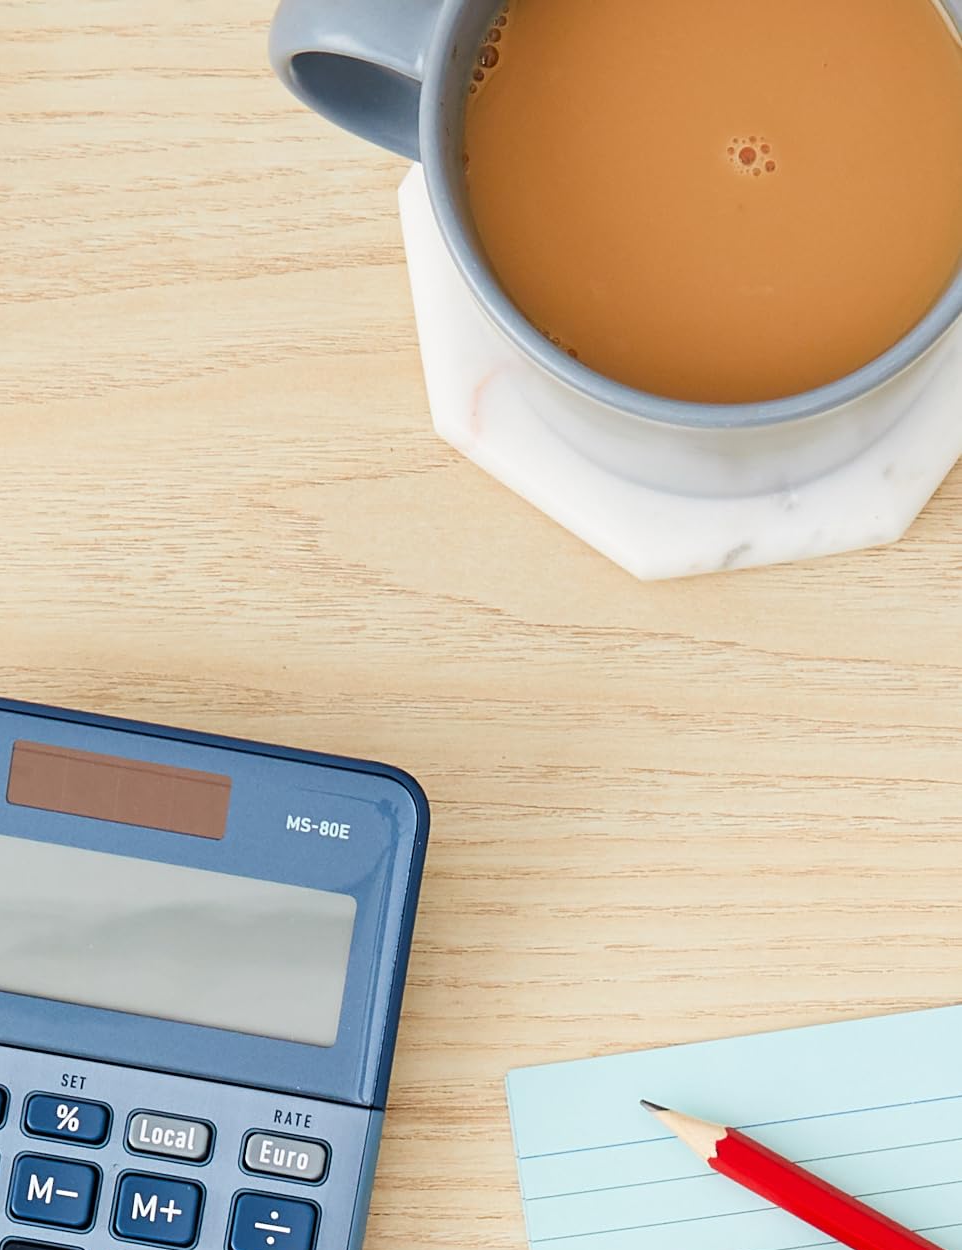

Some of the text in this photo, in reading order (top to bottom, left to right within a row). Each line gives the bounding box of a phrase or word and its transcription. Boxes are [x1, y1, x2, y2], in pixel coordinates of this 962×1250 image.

[286, 814, 351, 840] MS-80E
[61, 1073, 87, 1090] SET
[56, 1104, 80, 1132] %
[273, 1109, 312, 1129] RATE
[139, 1119, 195, 1150] Local
[259, 1140, 309, 1170] Euro
[131, 1192, 182, 1223] M+
